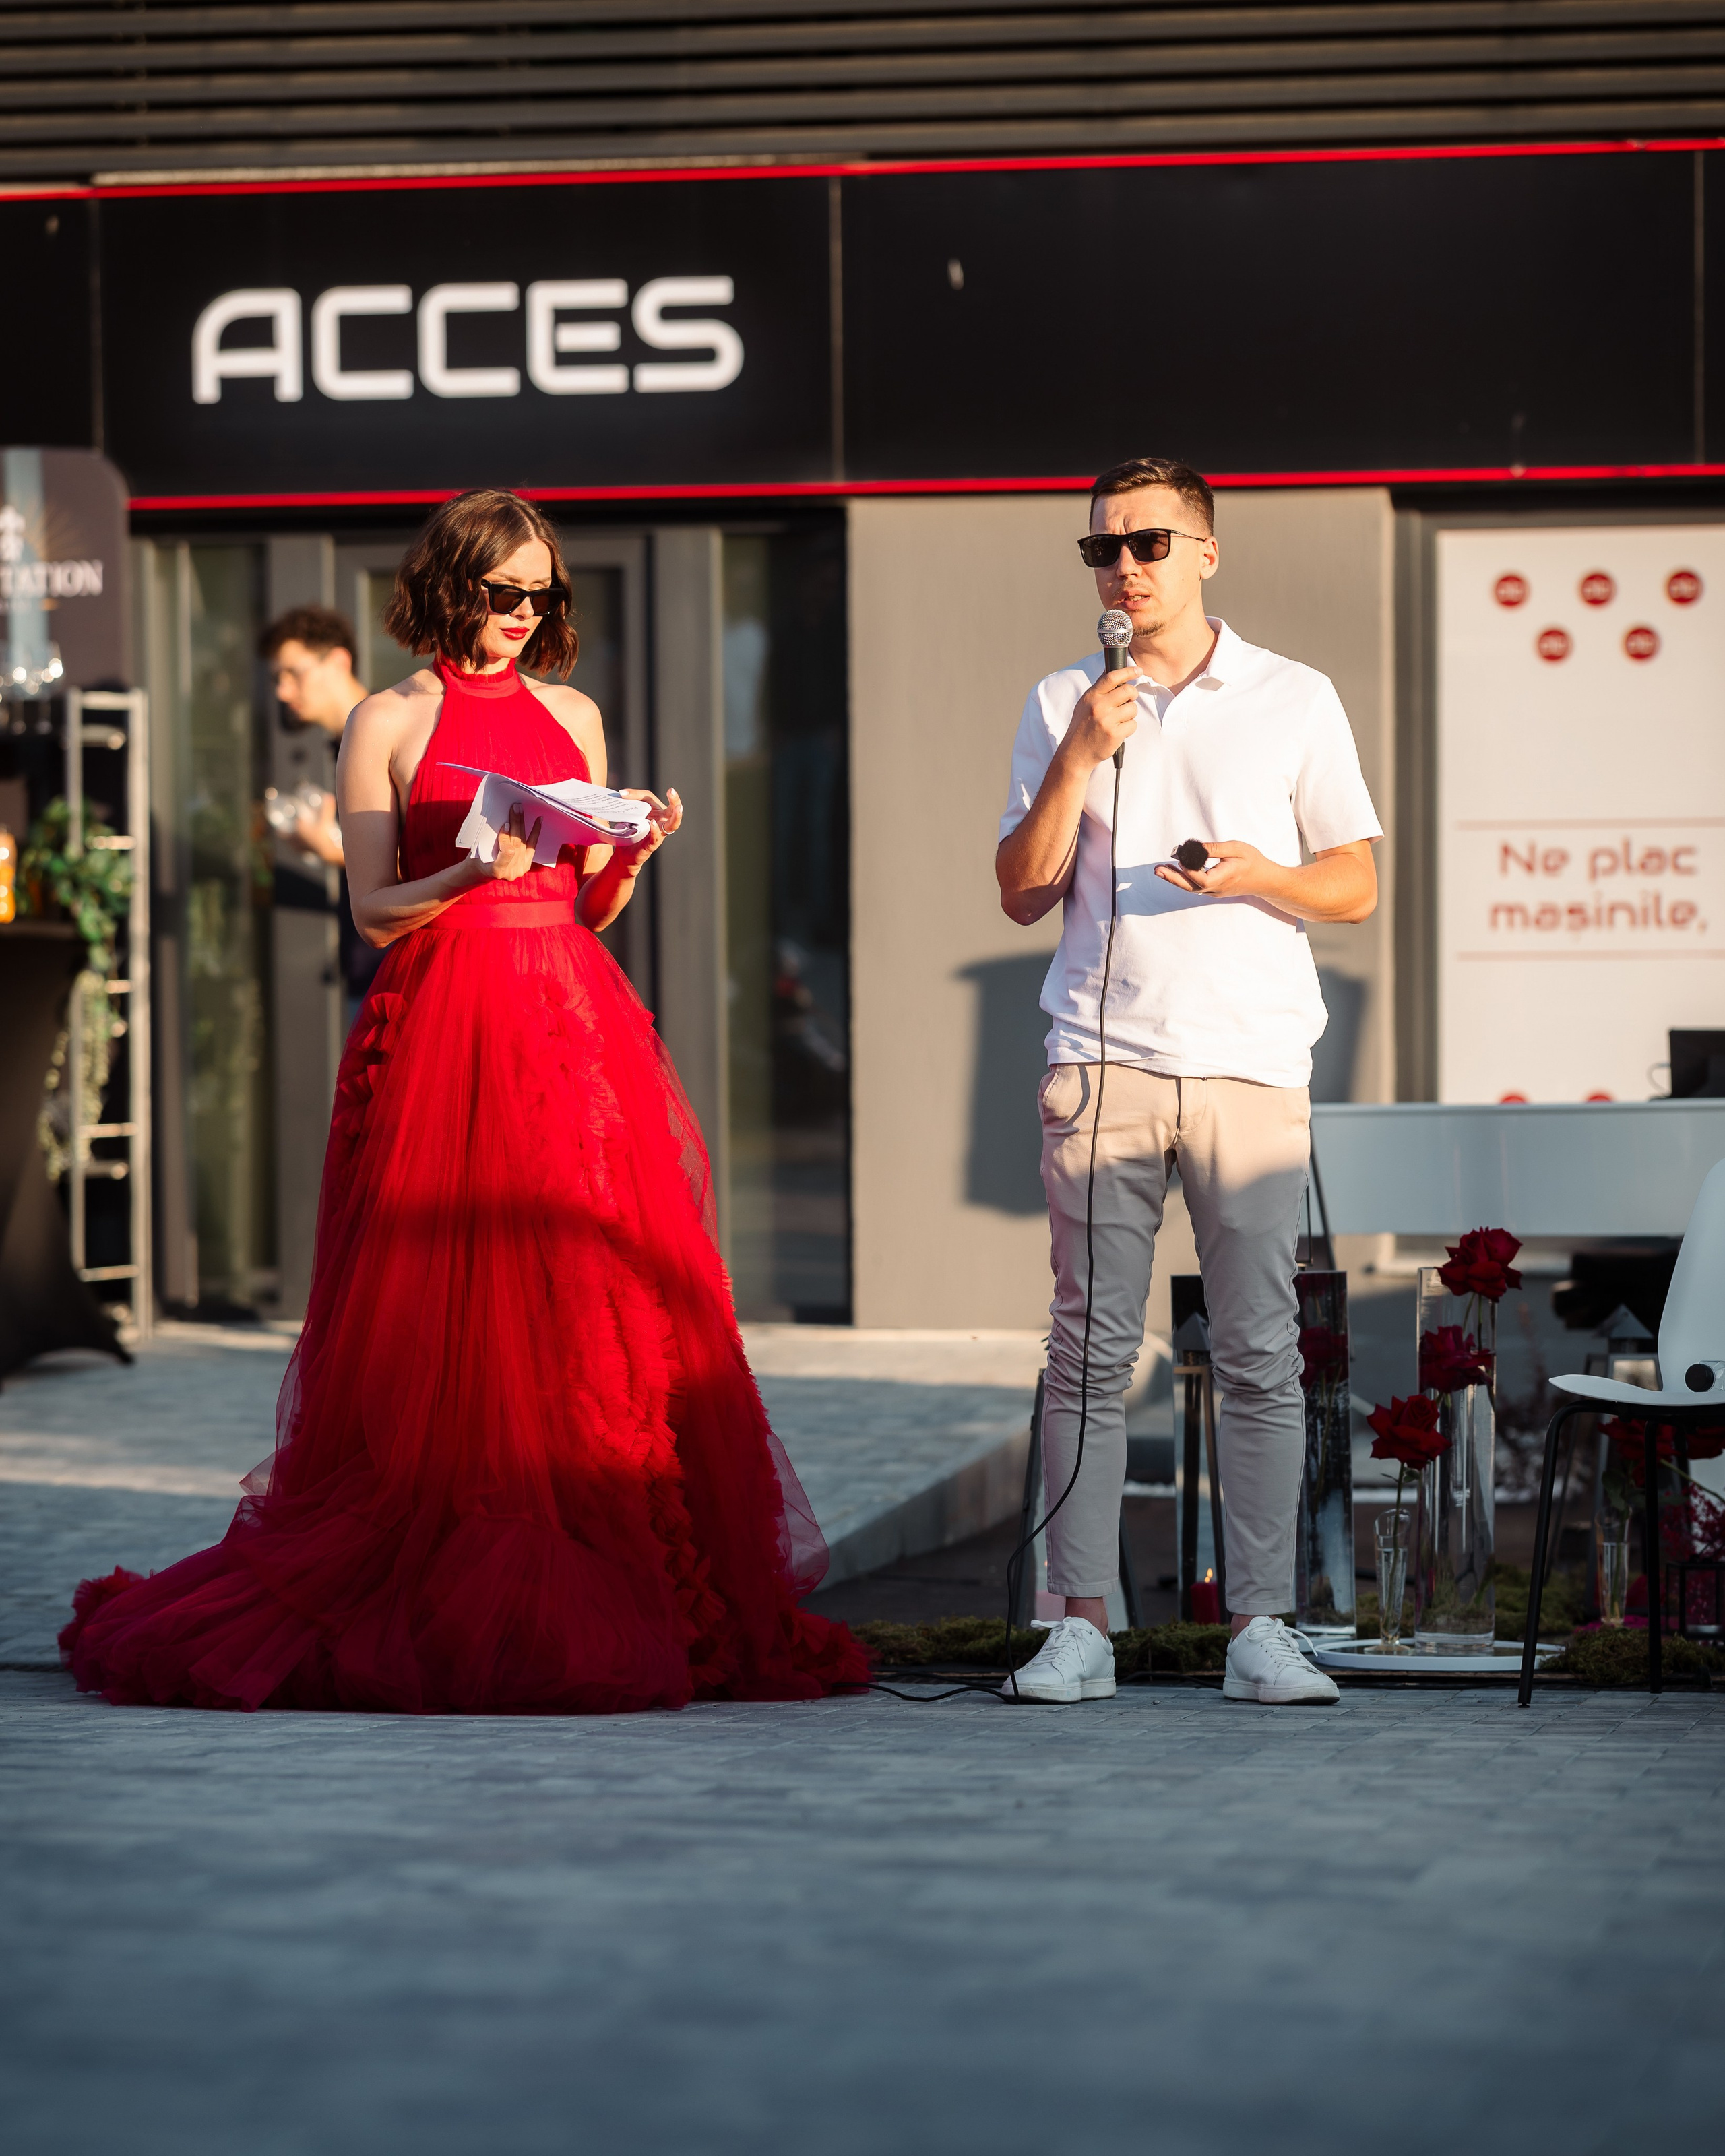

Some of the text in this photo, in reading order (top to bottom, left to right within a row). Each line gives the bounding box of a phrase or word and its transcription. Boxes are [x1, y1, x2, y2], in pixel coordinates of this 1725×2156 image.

[191, 275, 745, 404] ACCES
[1498, 835, 1699, 884] Ne plac
